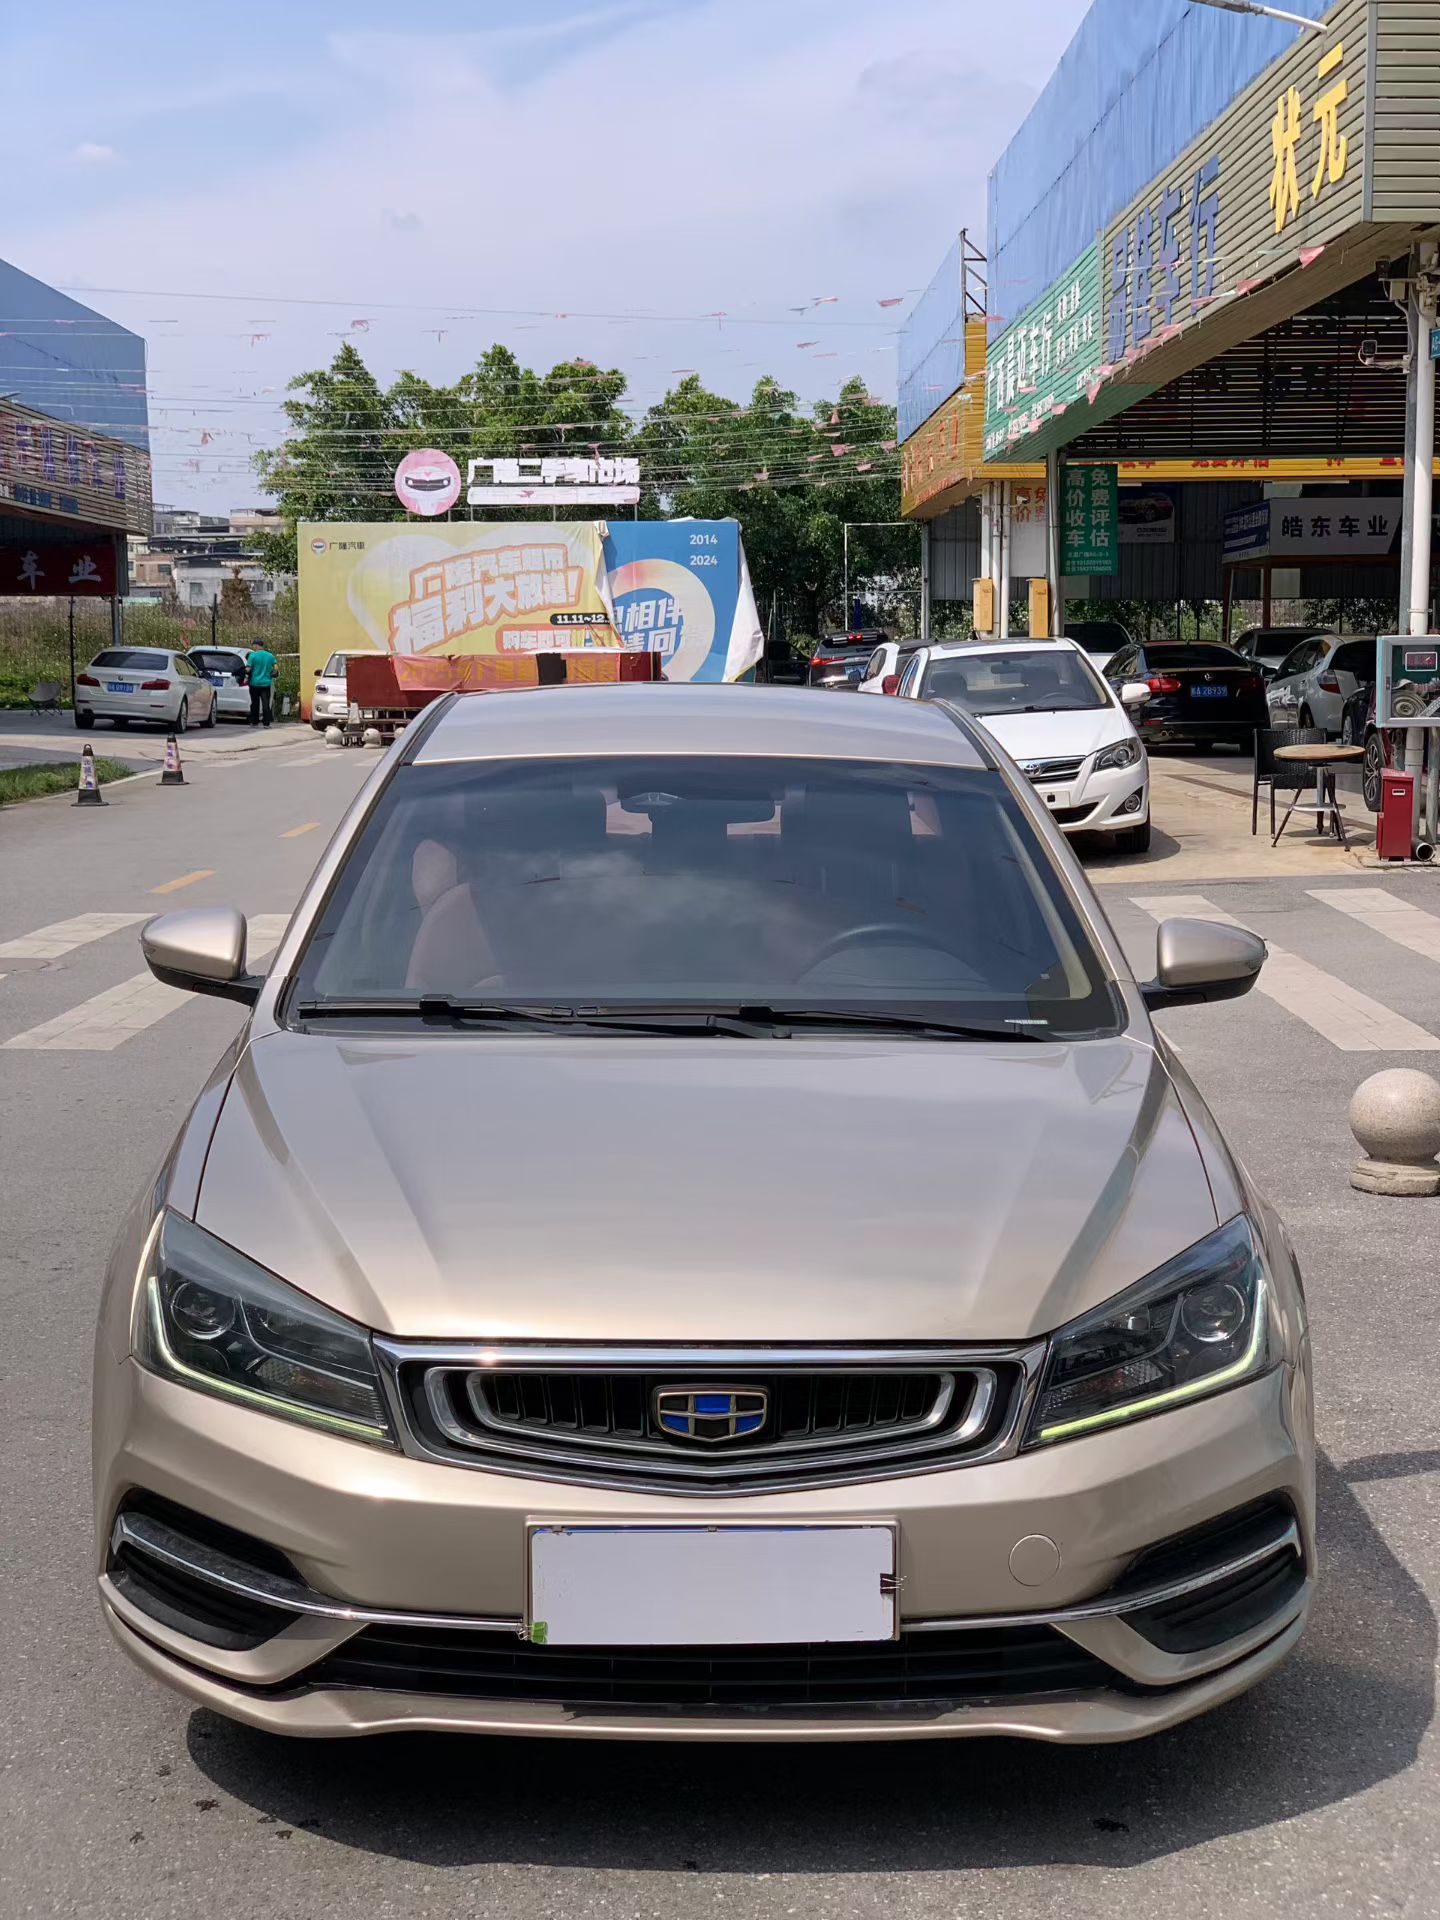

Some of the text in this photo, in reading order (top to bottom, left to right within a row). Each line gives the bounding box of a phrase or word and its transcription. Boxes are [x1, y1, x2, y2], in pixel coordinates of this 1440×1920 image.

[1269, 42, 1348, 234] 状元
[1065, 468, 1086, 548] 高价收车
[1089, 468, 1111, 548] 免费评估
[1281, 514, 1390, 538] 皓东车业
[689, 534, 718, 545] 2014
[689, 555, 718, 566] 2024
